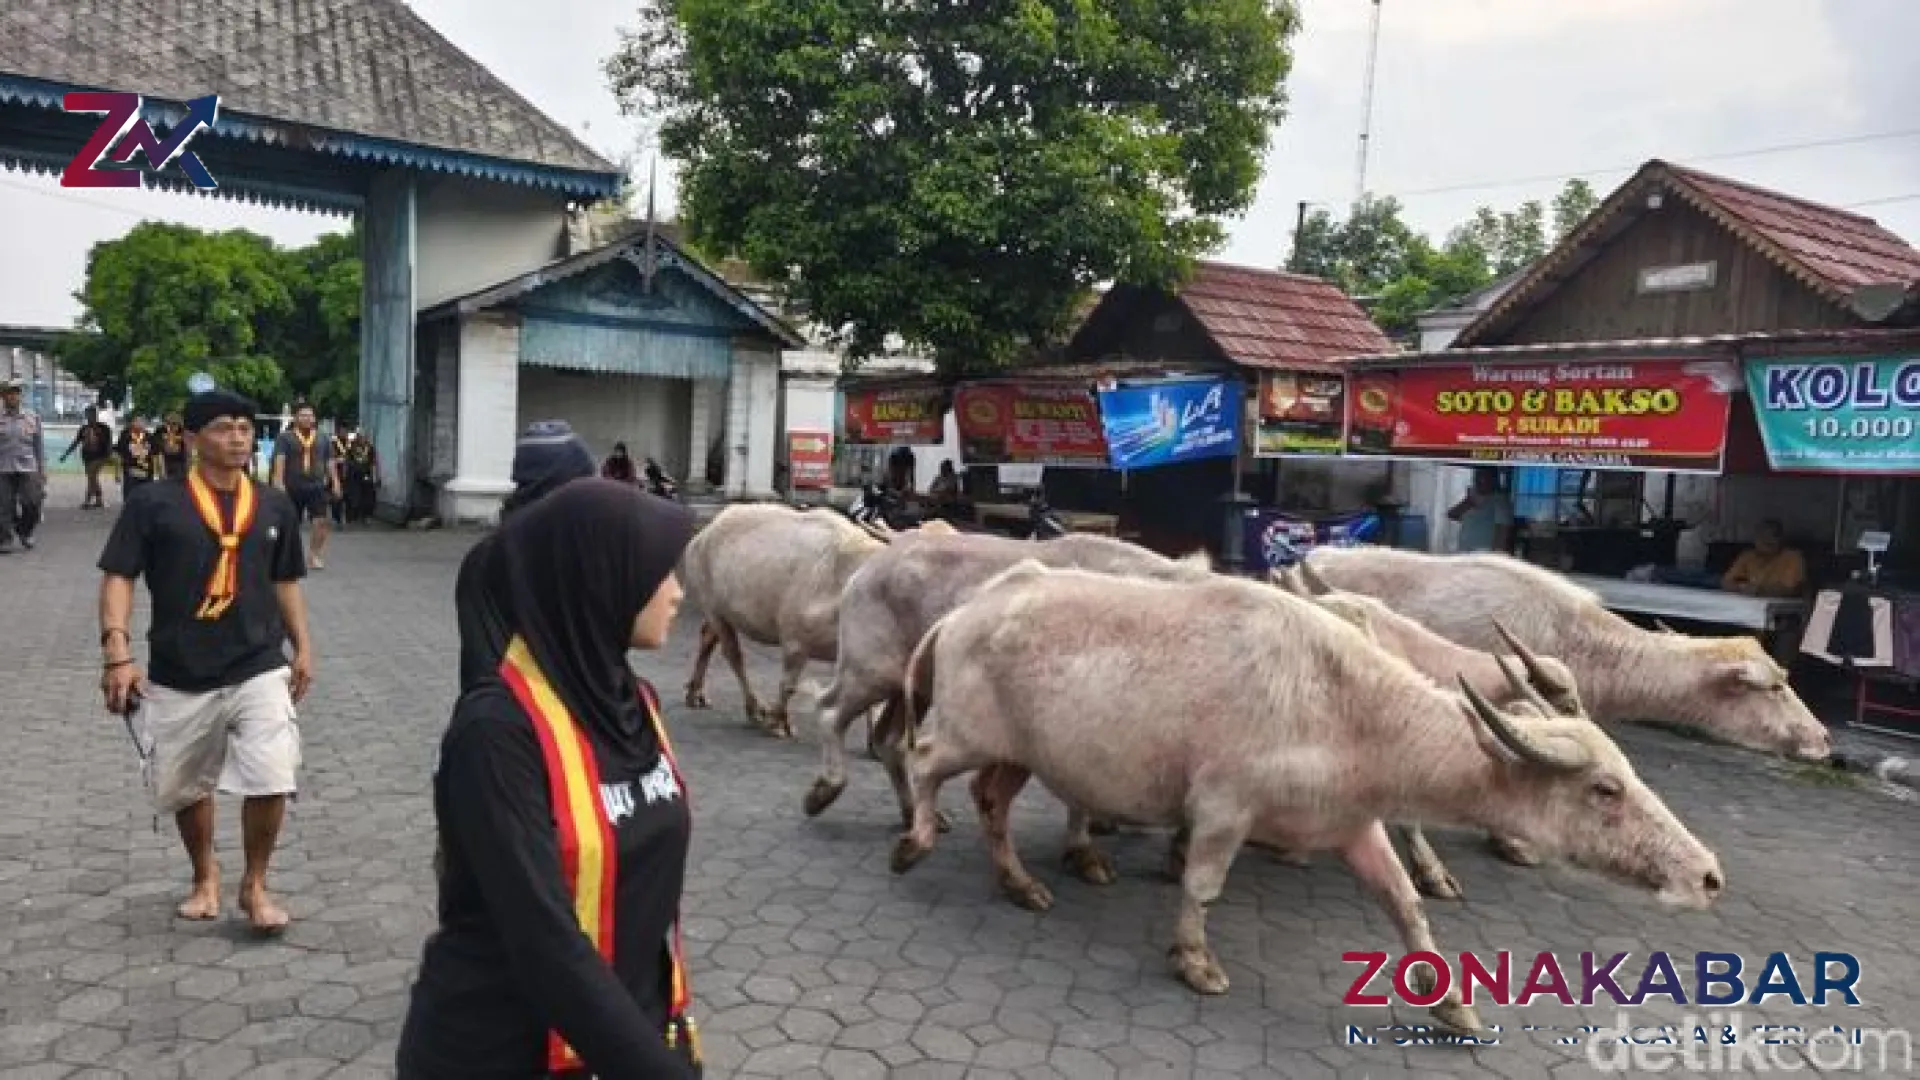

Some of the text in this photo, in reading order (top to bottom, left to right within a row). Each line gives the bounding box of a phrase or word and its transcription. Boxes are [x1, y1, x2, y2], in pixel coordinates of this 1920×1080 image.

[1437, 388, 1680, 415] SOTO & BAKSO
[1516, 415, 1600, 434] SURADI
[1803, 416, 1912, 438] 10.000
